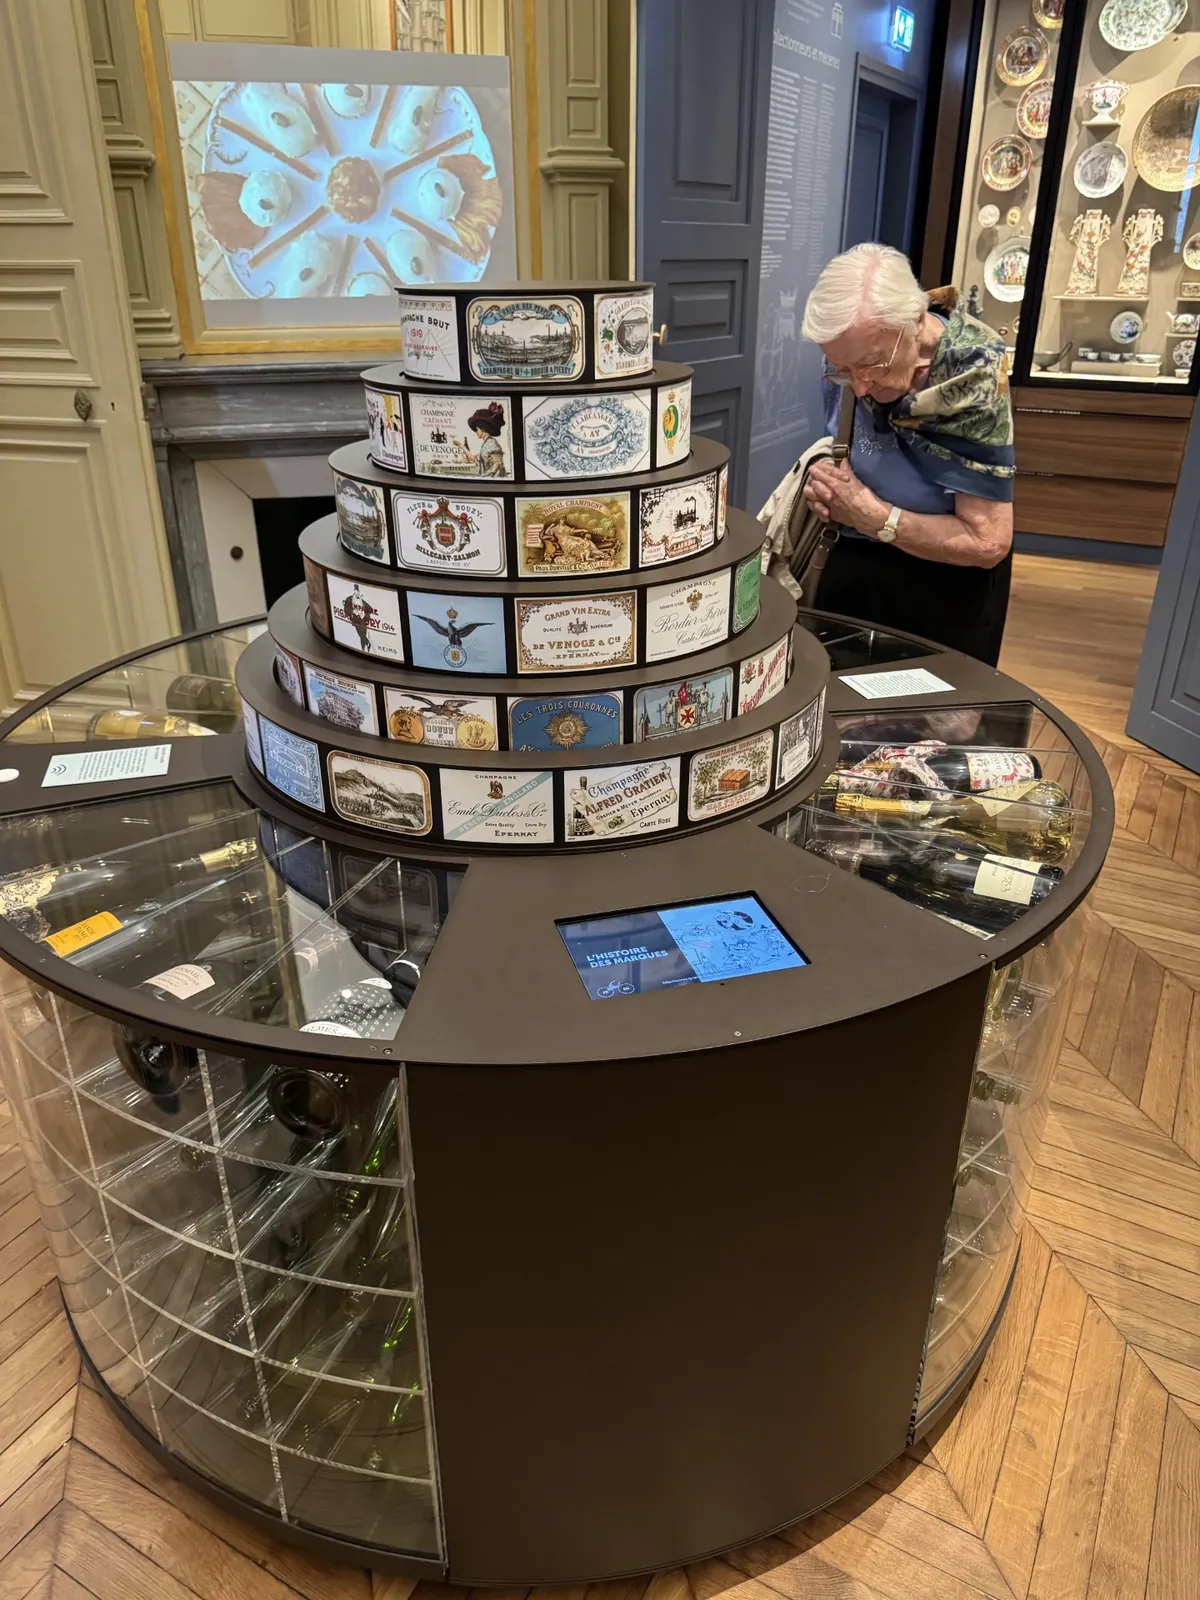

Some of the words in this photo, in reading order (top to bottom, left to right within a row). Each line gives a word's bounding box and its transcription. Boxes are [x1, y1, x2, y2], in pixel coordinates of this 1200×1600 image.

[427, 316, 450, 330] BRUT
[410, 328, 423, 338] 1919
[483, 366, 513, 375] CHAMPAGNE
[420, 408, 455, 417] CHAMPAGNE
[420, 444, 429, 452] DE
[429, 444, 462, 455] VENOGE
[407, 501, 426, 514] FLEUR
[543, 502, 564, 515] ROYAL
[565, 499, 604, 511] CHAMPAGNE
[415, 543, 481, 561] BILLECART-SALMON
[671, 580, 717, 598] CHAMPAGNE
[545, 609, 570, 621] GRAND
[571, 607, 586, 615] VIN
[587, 606, 611, 617] EXTRA
[651, 612, 700, 634] Bordier
[377, 645, 398, 654] REIMS
[547, 639, 595, 650] VENOGE
[556, 651, 600, 660] EPERNAY
[516, 710, 533, 724] LES
[536, 701, 563, 714] TROIS
[567, 700, 618, 719] COURONNES
[588, 766, 651, 798] Champagne
[503, 780, 538, 805] ENGLAND
[584, 794, 623, 816] ALFRED
[623, 771, 668, 798] GRATIEN
[448, 799, 480, 816] Emile
[480, 802, 524, 818] Duclos
[630, 792, 672, 818] Epernay
[639, 821, 657, 829] CARTE
[586, 946, 649, 962] L'HISTOIRE
[590, 959, 612, 969] DES
[614, 949, 669, 965] MARQUES
